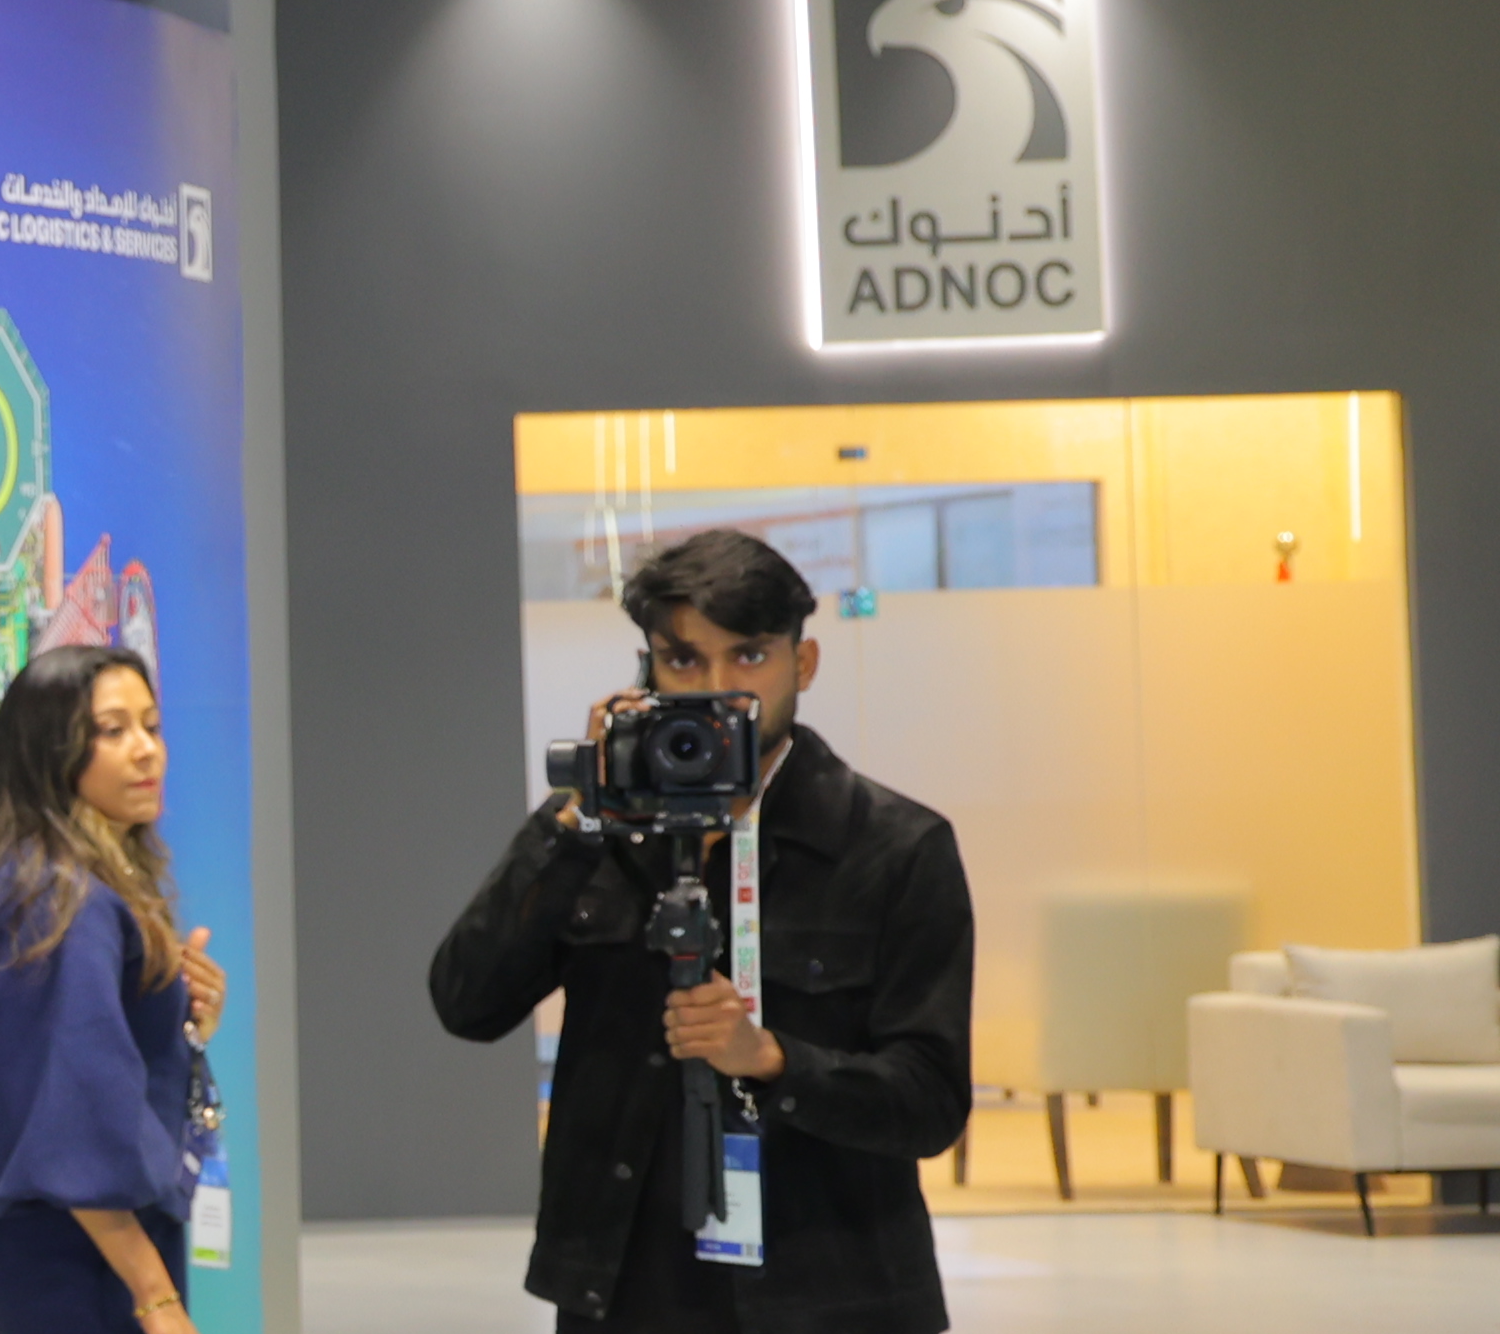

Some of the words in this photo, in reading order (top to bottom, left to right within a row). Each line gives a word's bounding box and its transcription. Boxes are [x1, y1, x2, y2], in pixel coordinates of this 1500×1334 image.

[11, 213, 101, 252] LOGISTICS
[114, 226, 179, 264] SERVICES
[846, 260, 1076, 317] ADNOC
